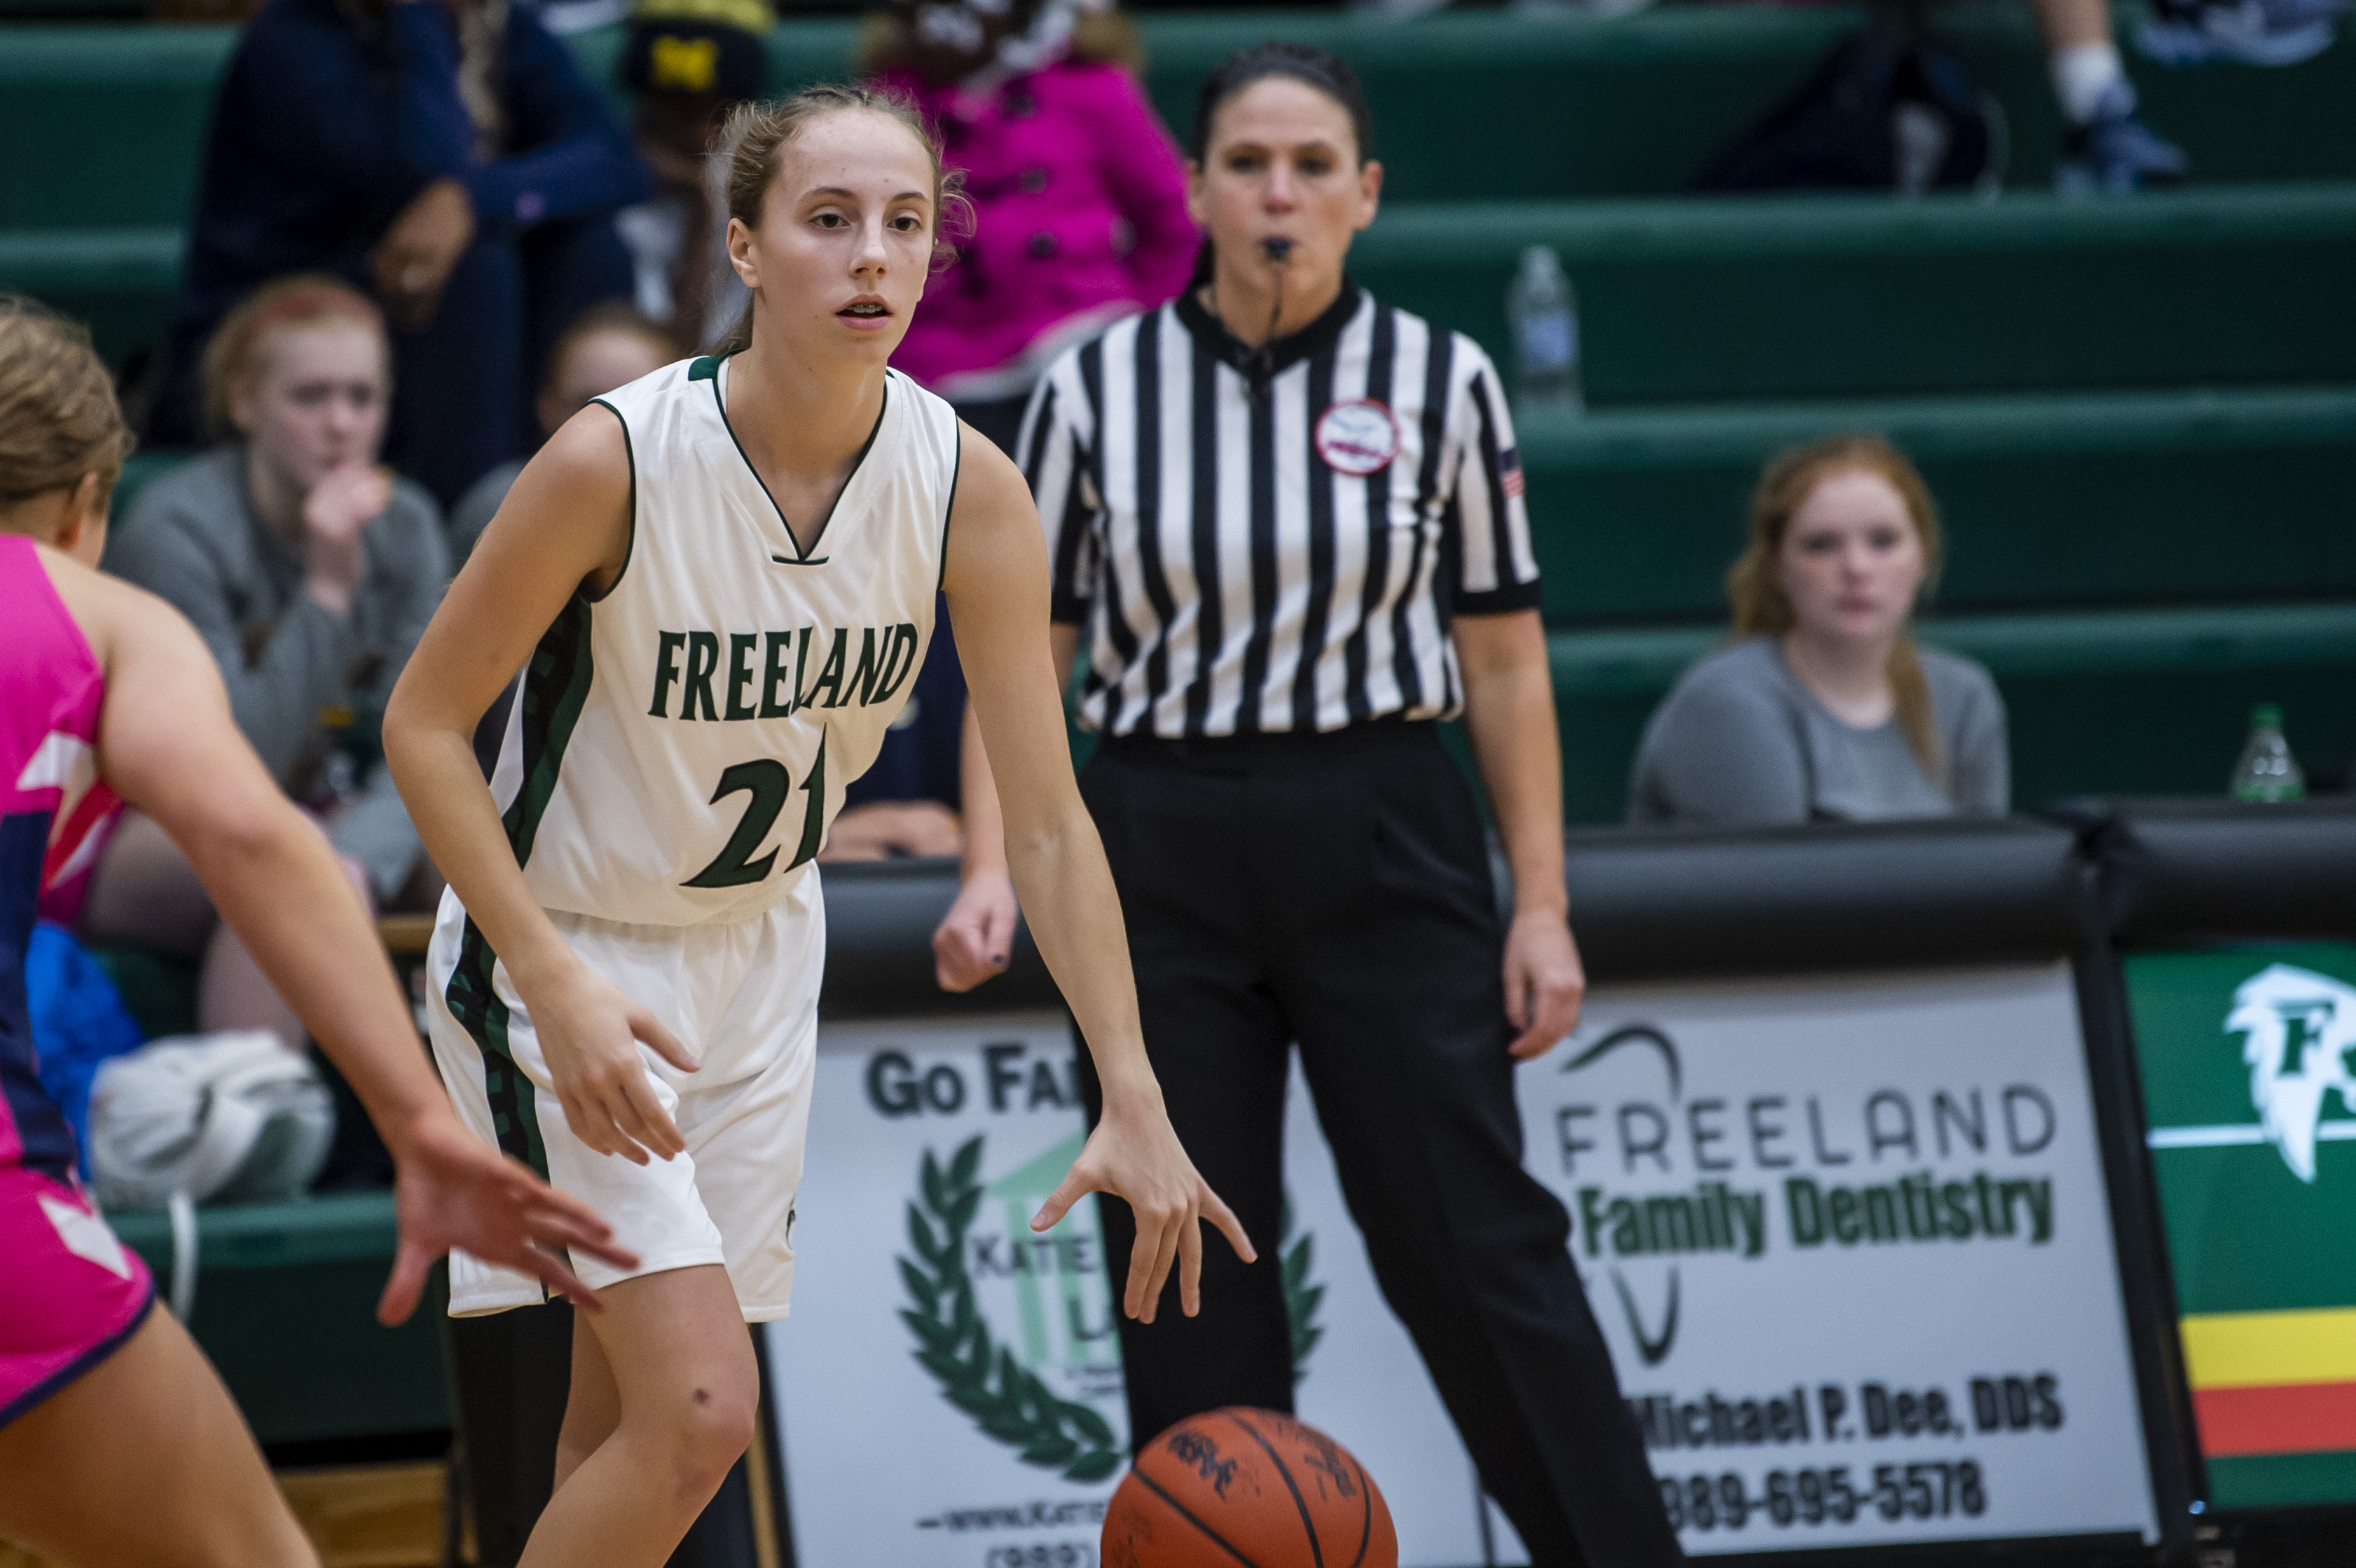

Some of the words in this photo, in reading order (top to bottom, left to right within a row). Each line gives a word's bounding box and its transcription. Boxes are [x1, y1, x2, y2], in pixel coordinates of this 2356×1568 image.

[647, 623, 918, 721] FREELAND
[679, 722, 827, 888] 21
[1555, 1083, 2055, 1178] FREELAND
[1576, 1180, 1767, 1259] Family
[1783, 1166, 2053, 1249] Dentistry
[1861, 1382, 1964, 1440] Dee,
[1970, 1373, 2064, 1433] DDS
